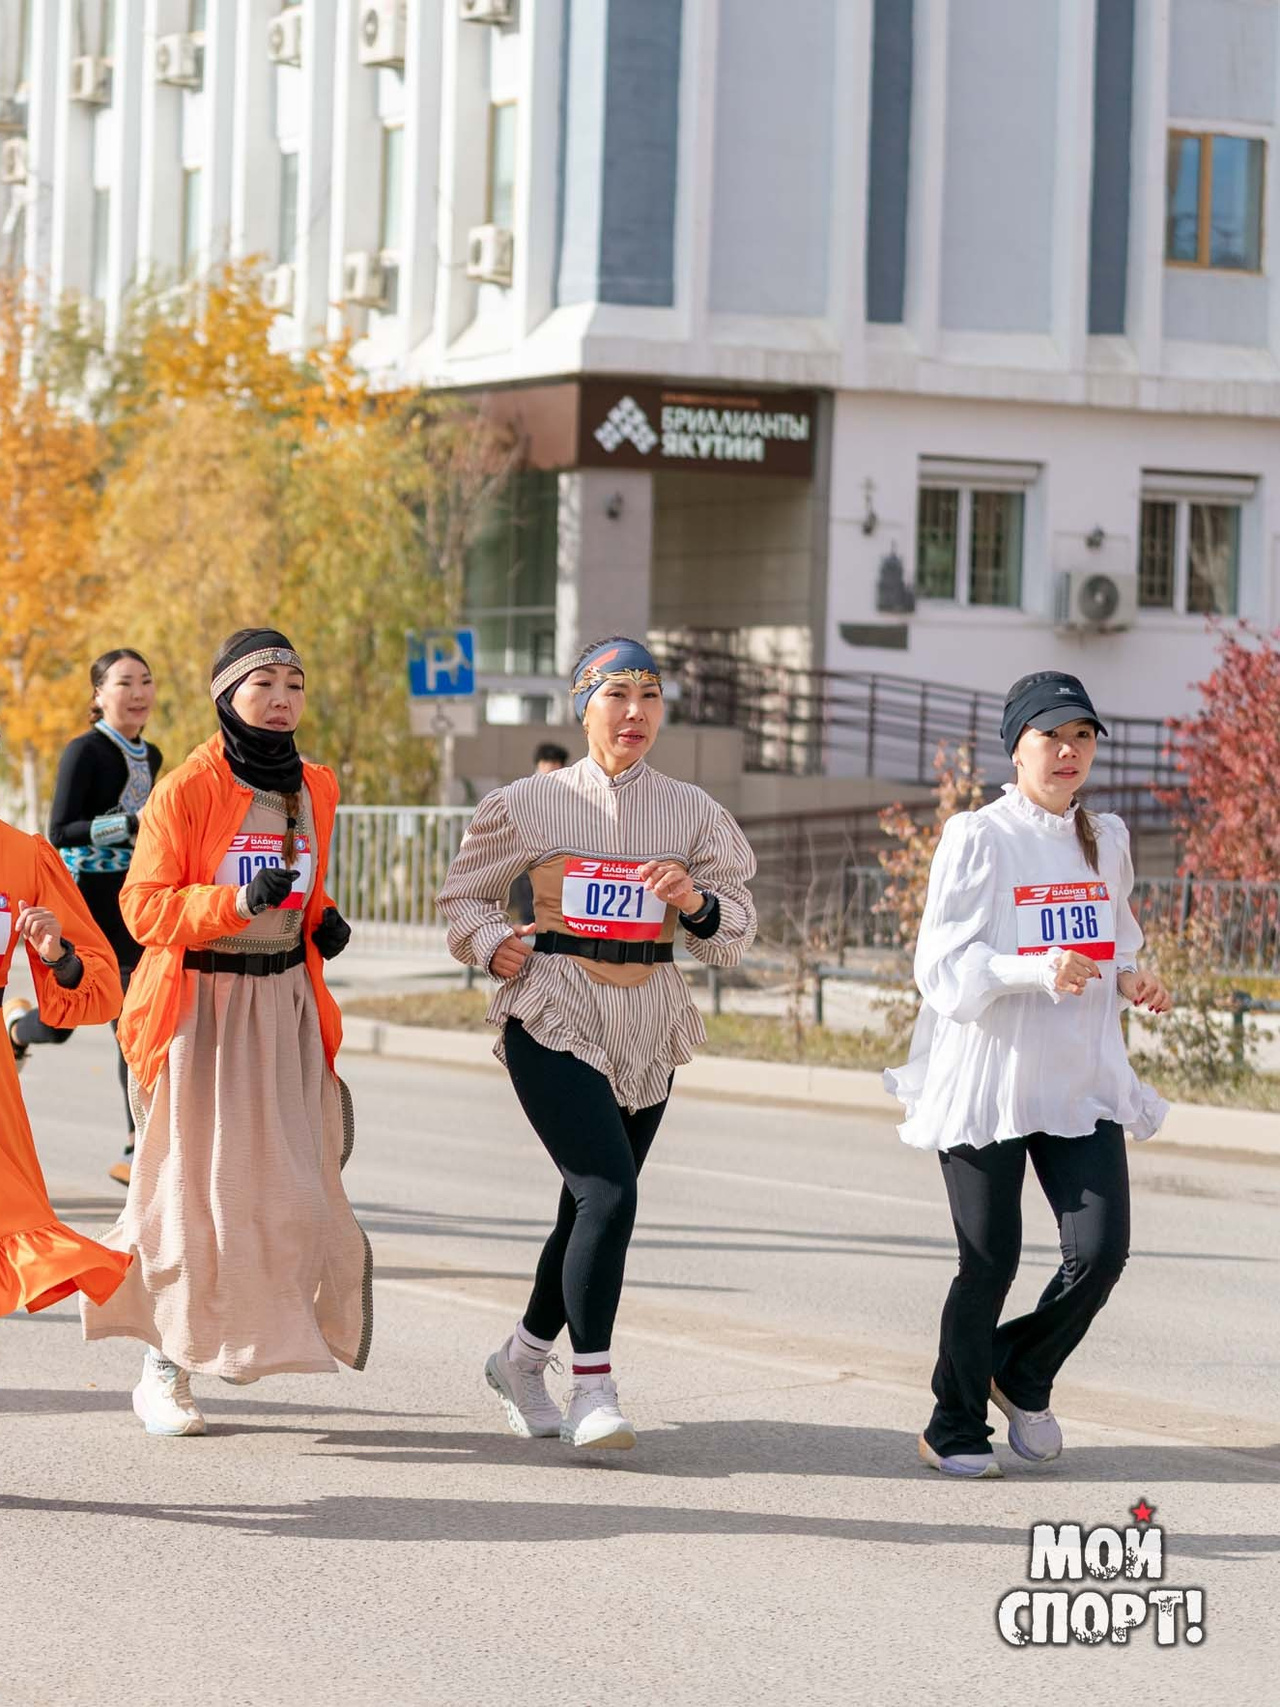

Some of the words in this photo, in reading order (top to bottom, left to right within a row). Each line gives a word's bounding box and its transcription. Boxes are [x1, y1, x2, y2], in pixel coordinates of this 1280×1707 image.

[661, 406, 809, 441] БРИЛЛИАНТЫ
[661, 433, 765, 462] ЯКУТИИ
[585, 883, 644, 918] 0221
[567, 921, 608, 933] ЯКУТСК
[1041, 905, 1099, 941] 0136
